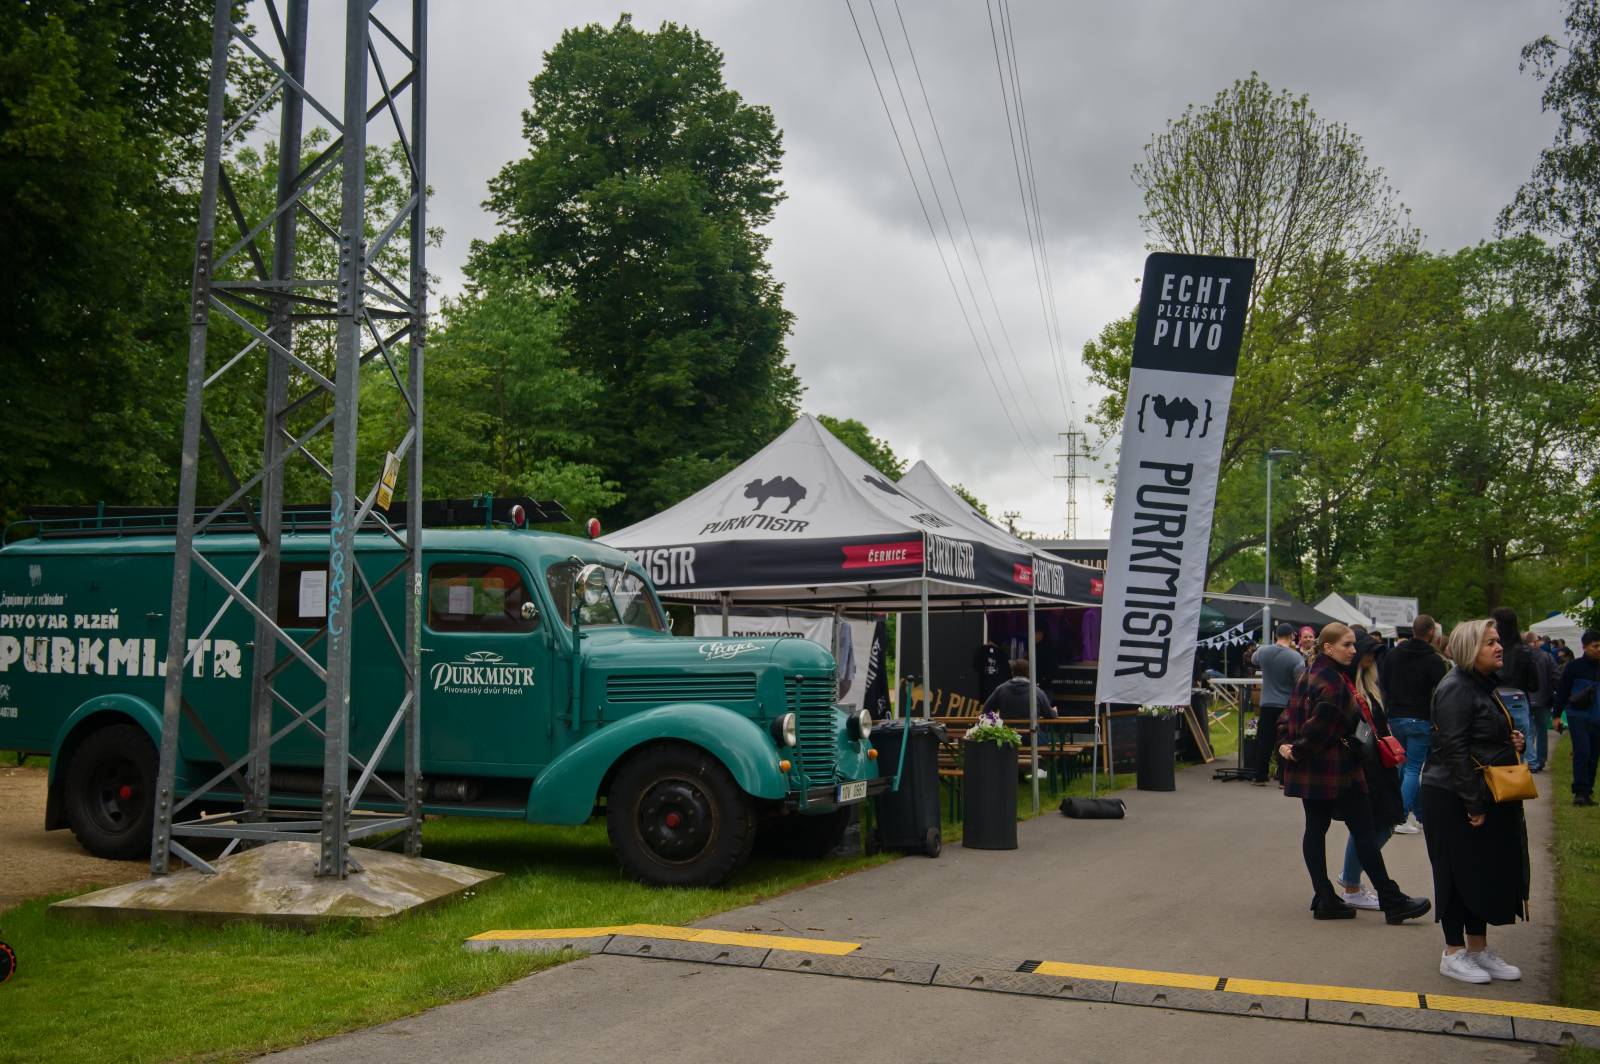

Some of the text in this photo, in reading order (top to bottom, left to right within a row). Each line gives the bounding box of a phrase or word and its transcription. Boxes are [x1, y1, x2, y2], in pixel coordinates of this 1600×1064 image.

[1160, 273, 1231, 305] ECHT
[1157, 303, 1227, 321] PLZEŇSKÝ
[1153, 319, 1223, 351] PIVO
[698, 513, 810, 536] PURKMISTR
[867, 549, 908, 563] ČERNICE
[926, 532, 976, 580] PURKMISTR
[1114, 460, 1194, 680] PURKMISTR
[1032, 557, 1065, 597] PURKMISTR
[0, 607, 119, 630] PIVOVAR PLZEŇ
[430, 662, 535, 690] PURKMISTR
[444, 685, 523, 696] Pivovarský dvůr Plzeň
